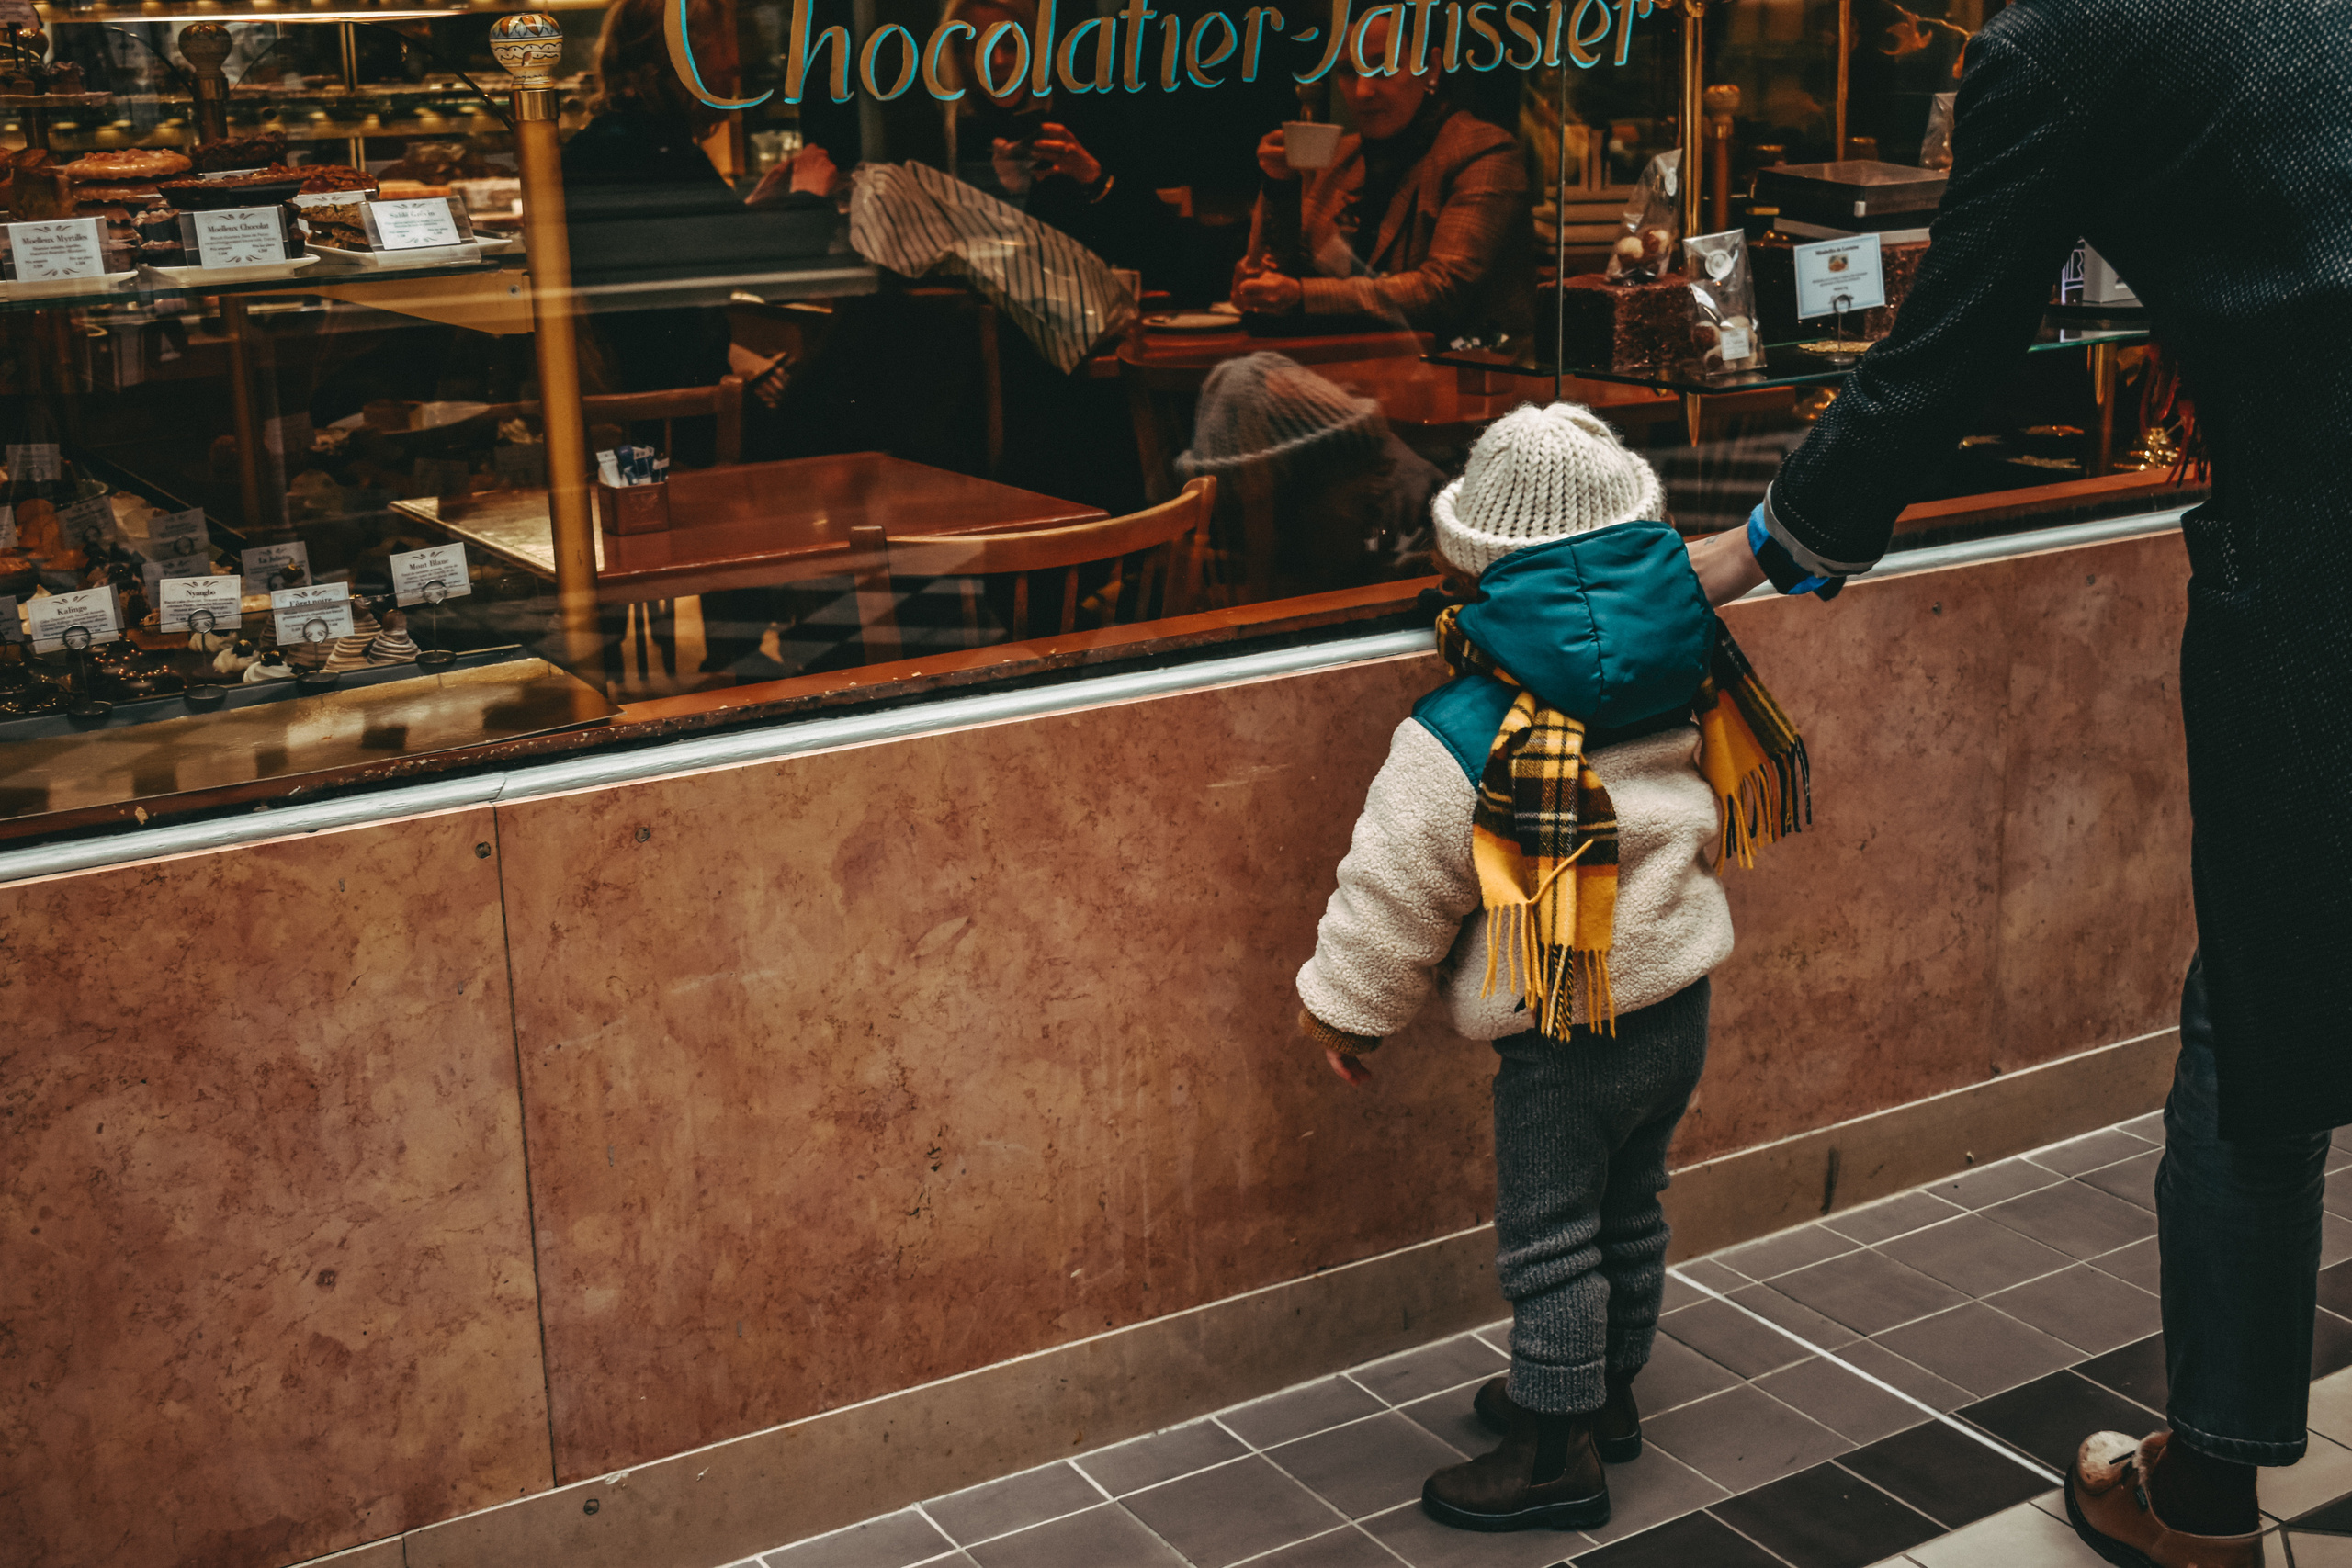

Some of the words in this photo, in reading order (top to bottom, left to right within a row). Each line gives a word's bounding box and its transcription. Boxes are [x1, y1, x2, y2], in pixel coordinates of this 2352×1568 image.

[208, 224, 238, 233] Moelleux
[240, 222, 269, 231] Chocolat
[22, 236, 54, 245] Moelleux
[56, 233, 88, 244] Myrtilles
[429, 558, 448, 567] Blanc
[186, 589, 216, 598] Nyangbo
[57, 605, 87, 615] Kalingo
